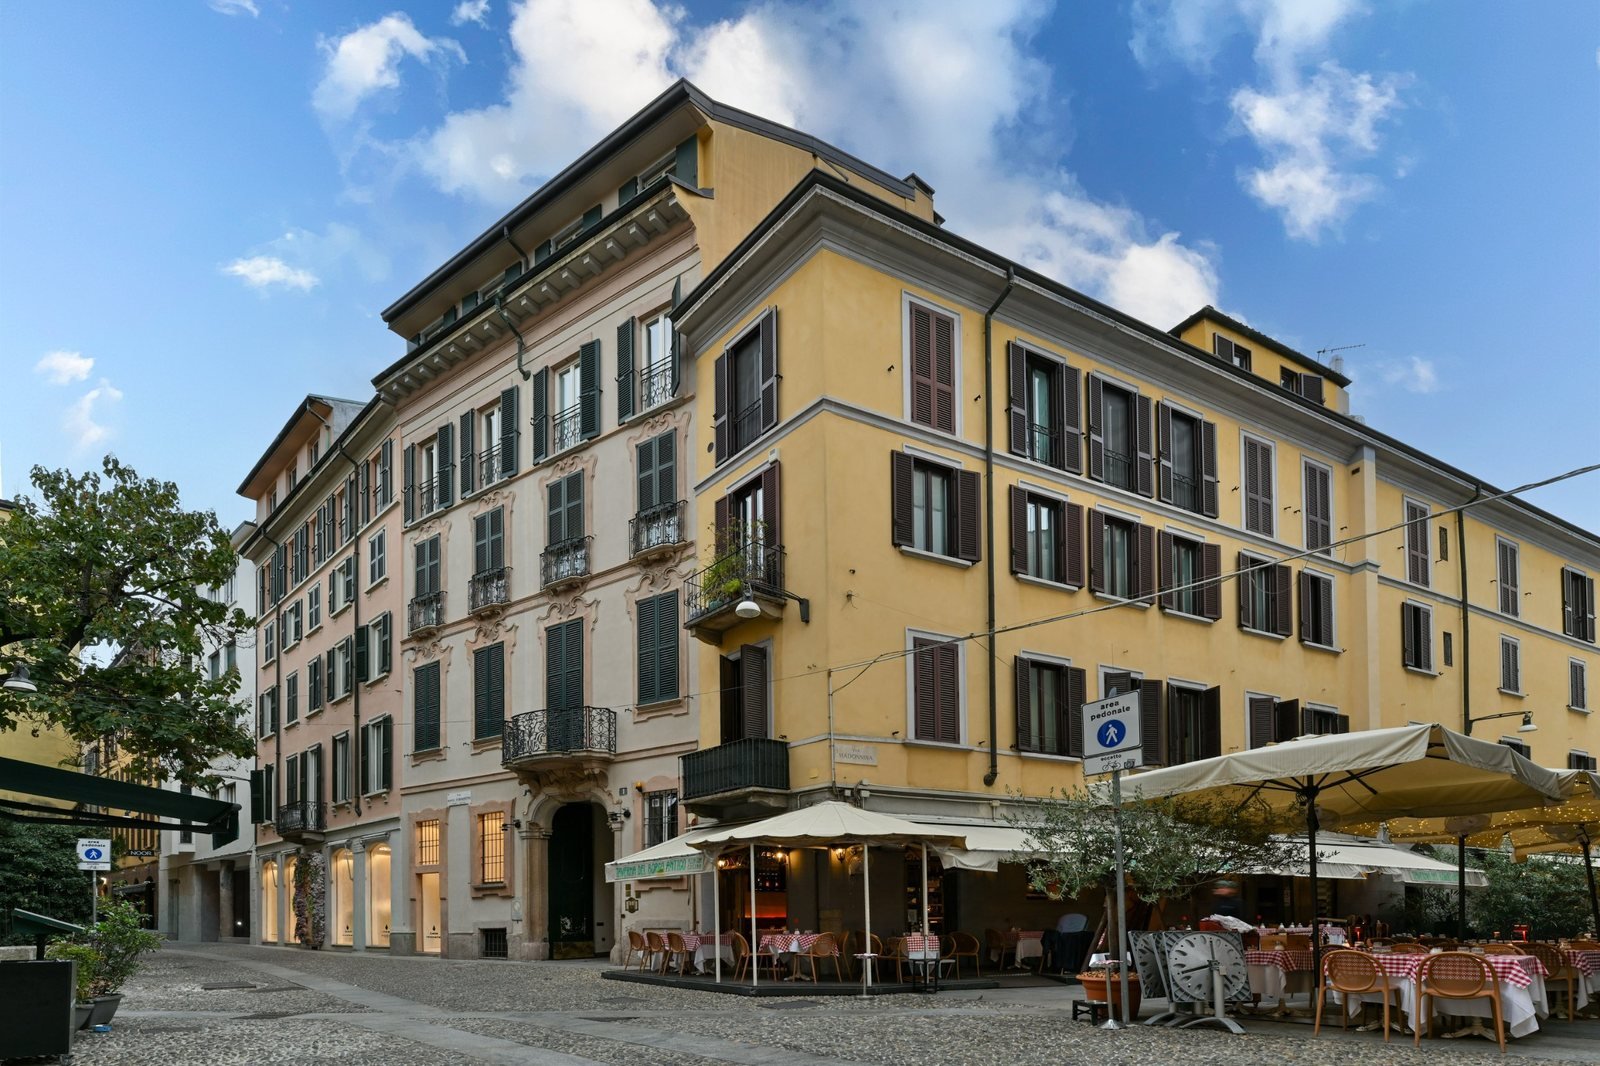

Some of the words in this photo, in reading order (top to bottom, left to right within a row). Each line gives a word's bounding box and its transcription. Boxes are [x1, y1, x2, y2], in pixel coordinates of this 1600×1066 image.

[1100, 701, 1119, 710] area
[1091, 706, 1131, 721] pedonale
[666, 858, 686, 872] ANTICO
